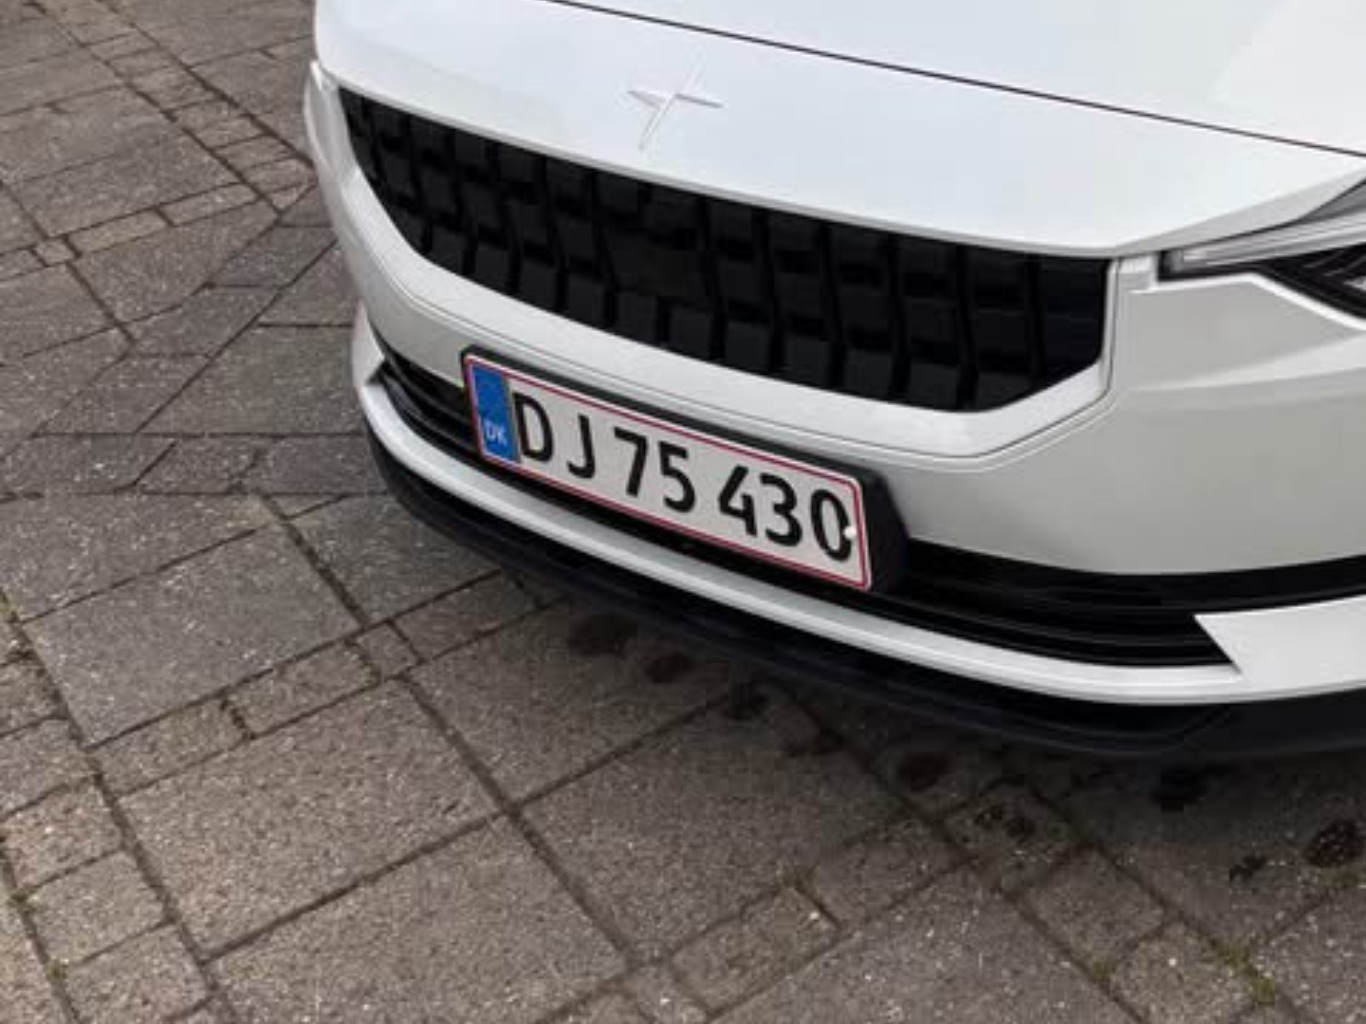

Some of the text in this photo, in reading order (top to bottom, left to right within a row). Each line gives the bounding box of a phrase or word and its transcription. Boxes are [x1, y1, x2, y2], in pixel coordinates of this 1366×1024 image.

[484, 419, 508, 447] DK
[513, 392, 853, 562] DJ 75 430
